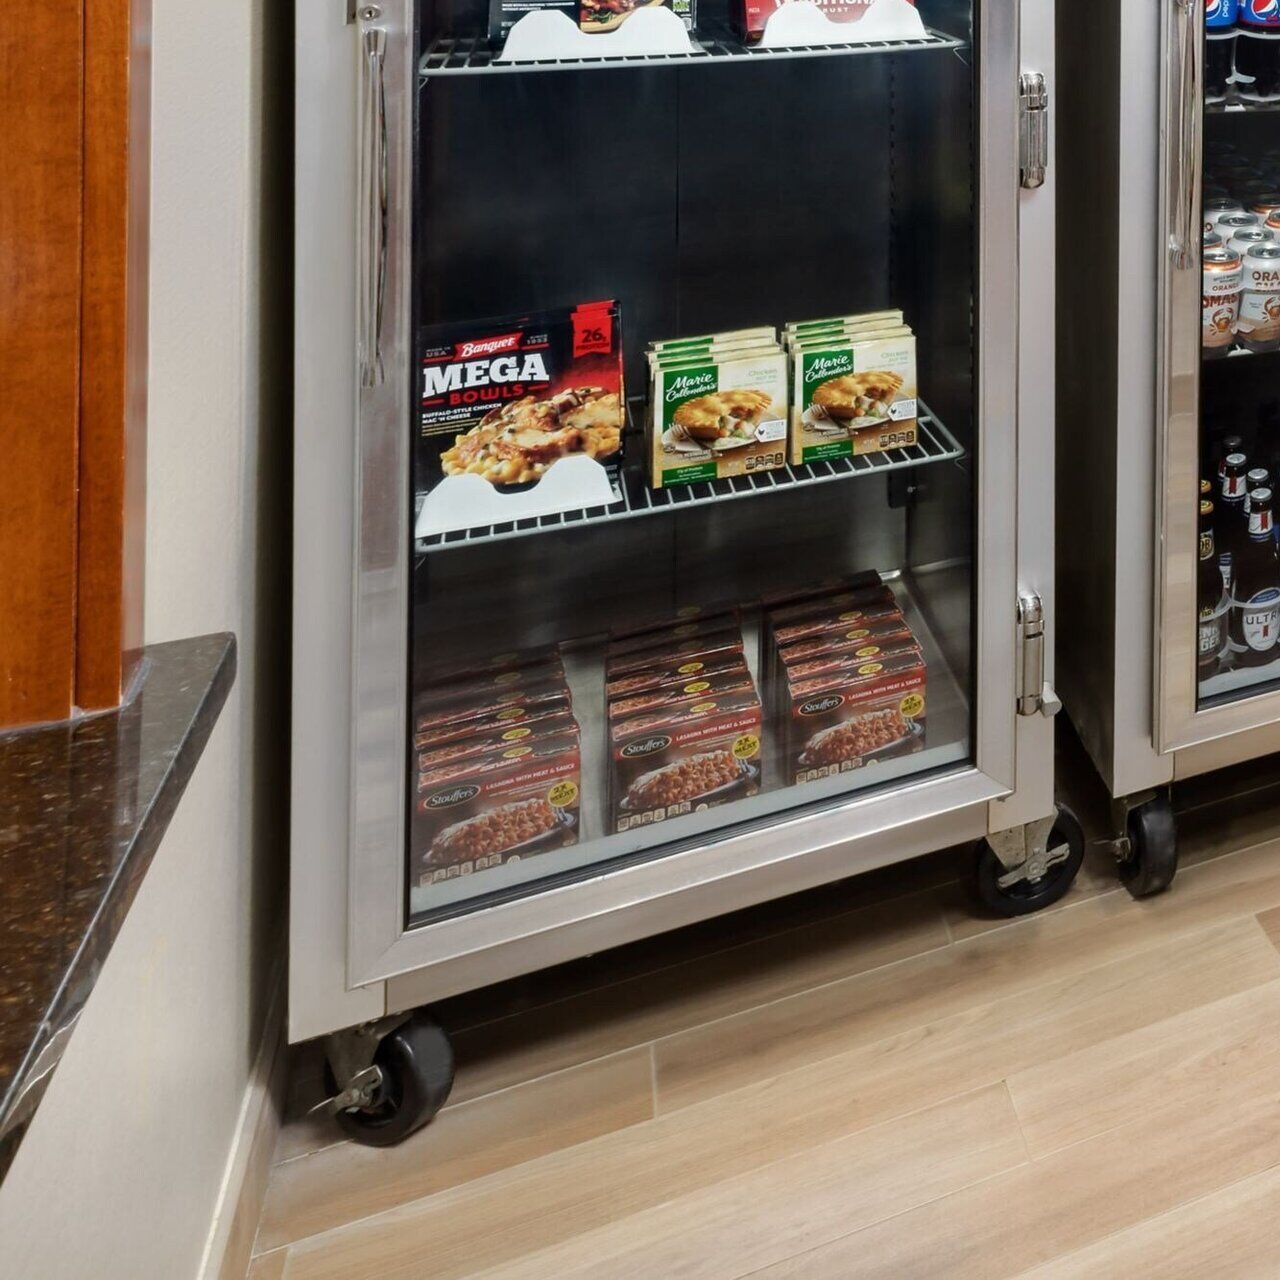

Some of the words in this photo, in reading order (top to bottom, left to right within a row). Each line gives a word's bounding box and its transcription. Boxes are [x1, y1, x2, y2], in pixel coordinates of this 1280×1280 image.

[461, 338, 515, 357] Banquet
[423, 353, 549, 398] MEGA
[672, 372, 714, 390] Marie
[451, 384, 524, 405] BOWLS
[666, 381, 716, 402] Callender's
[447, 412, 471, 420] CHEESE
[473, 403, 502, 411] CHICKEN
